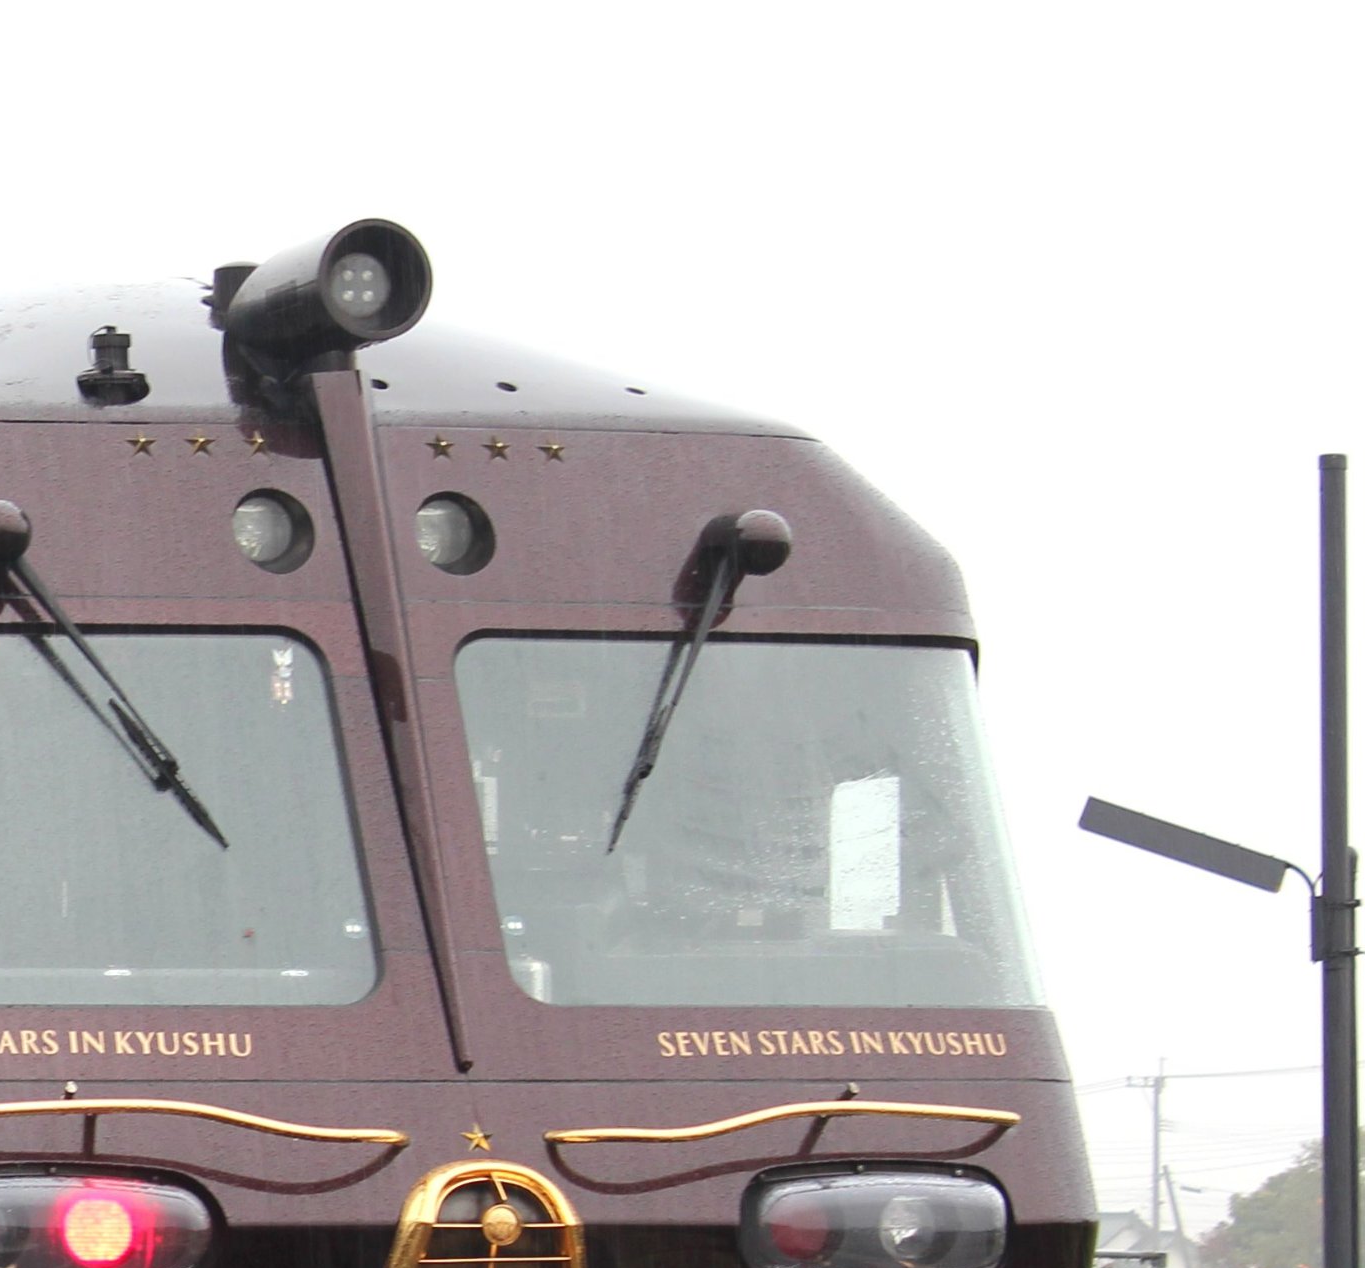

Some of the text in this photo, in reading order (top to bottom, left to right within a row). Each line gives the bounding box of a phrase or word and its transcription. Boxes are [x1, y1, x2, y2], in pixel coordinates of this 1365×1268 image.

[69, 1030, 106, 1055] IN
[114, 1030, 253, 1058] KYUSHU
[657, 1030, 1008, 1058] SEVEN STARS IN KYUSHU
